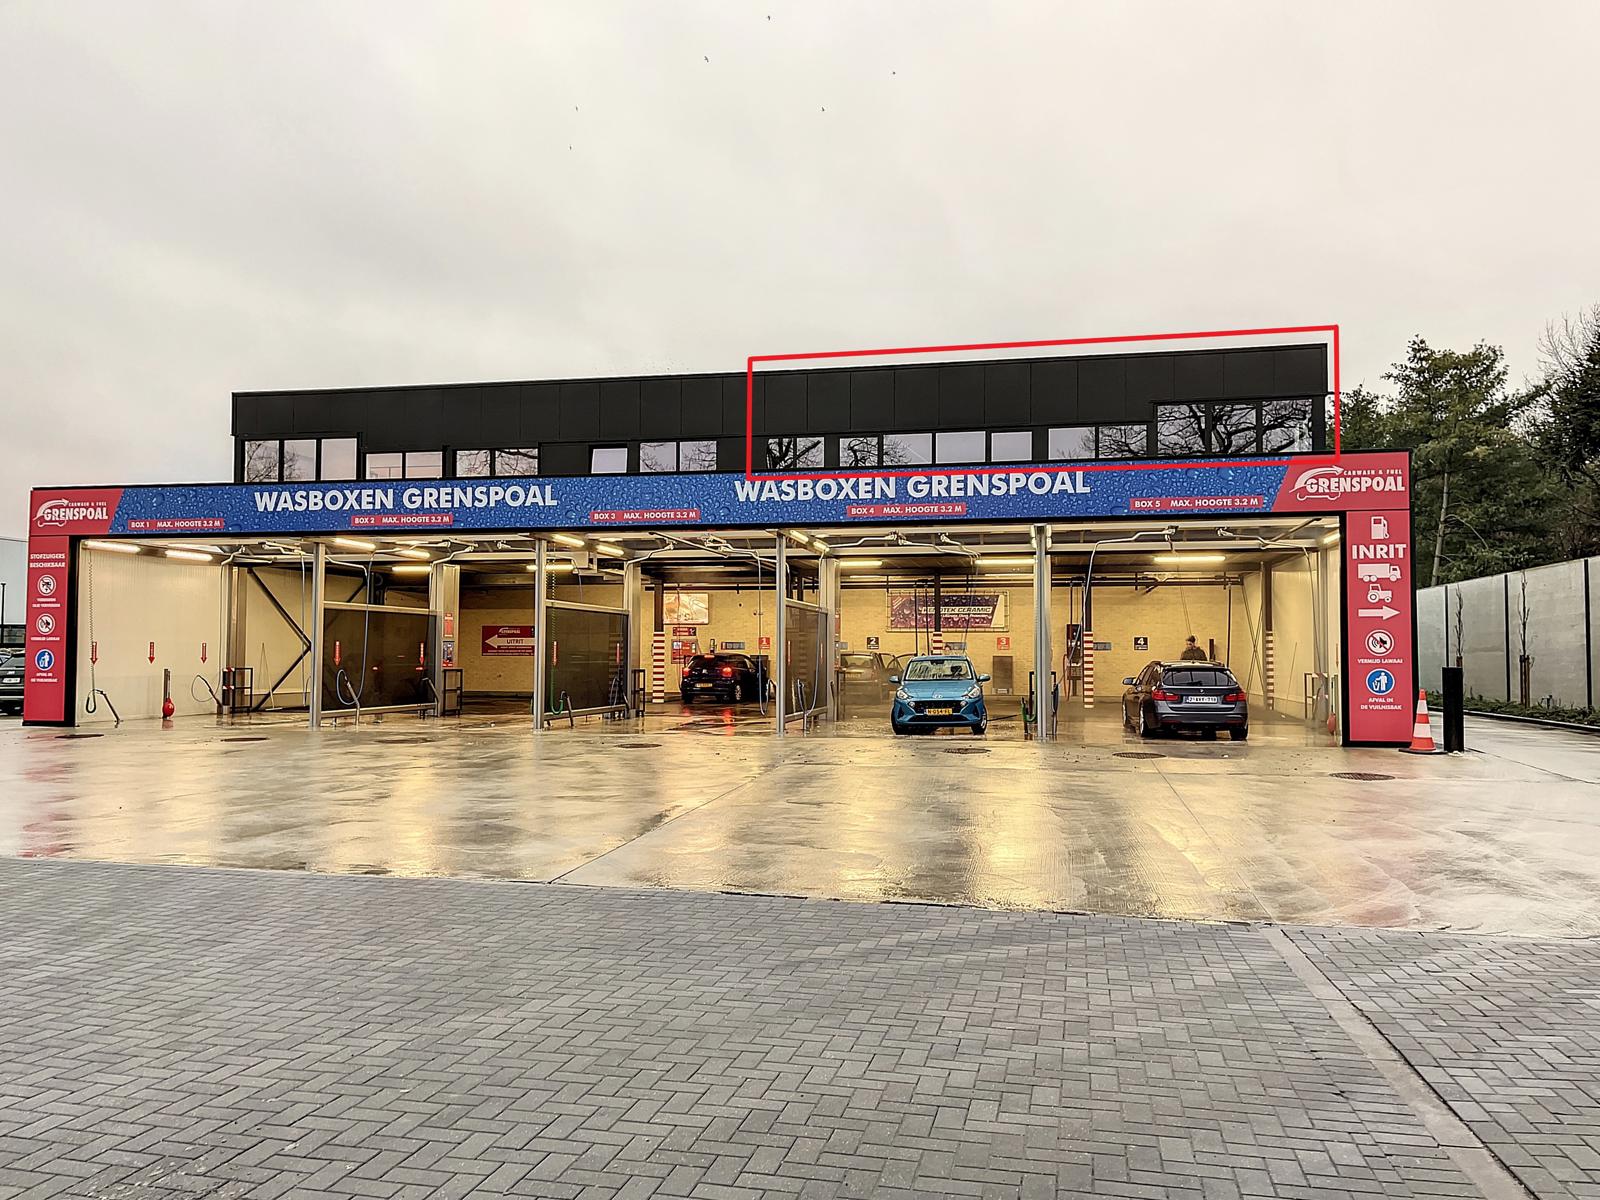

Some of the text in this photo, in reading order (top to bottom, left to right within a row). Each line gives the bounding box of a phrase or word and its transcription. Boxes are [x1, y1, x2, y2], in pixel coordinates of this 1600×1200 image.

[734, 471, 1090, 501] WASBOXEN GRENSPOAL
[1306, 476, 1405, 493] GRENSPOAL
[254, 486, 557, 512] WASBOXEN GRENSPOAL
[44, 507, 108, 520] GRENSPOAL
[1352, 544, 1406, 559] INRIT
